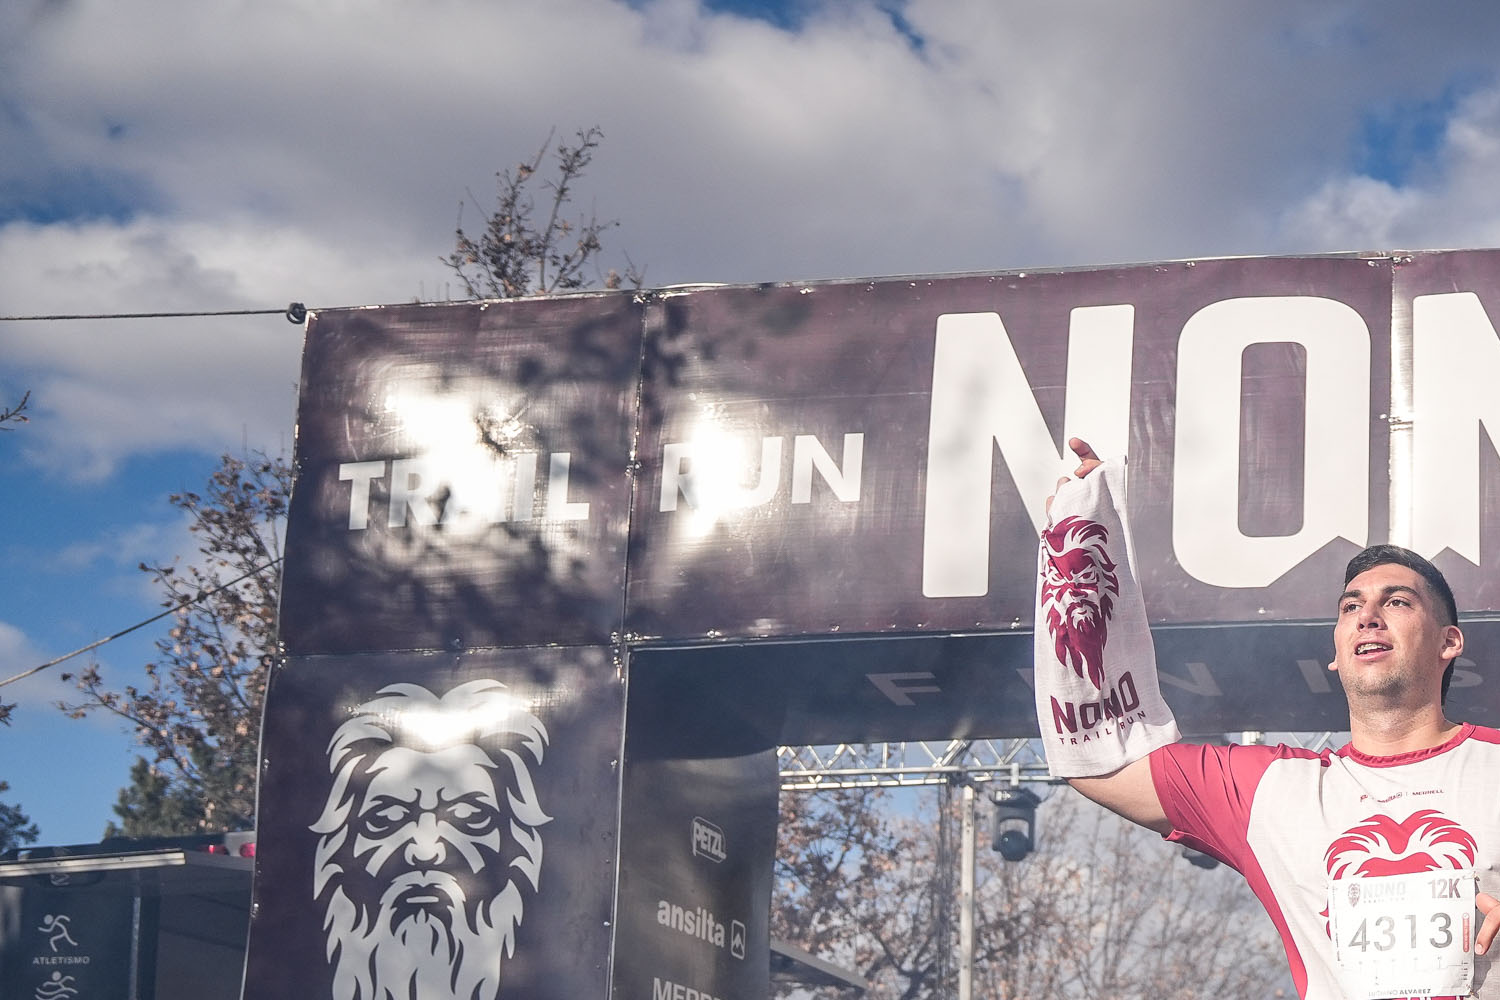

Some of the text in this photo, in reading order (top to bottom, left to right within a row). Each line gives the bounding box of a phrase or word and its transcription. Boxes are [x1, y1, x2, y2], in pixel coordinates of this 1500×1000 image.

[660, 432, 864, 512] RUN
[1050, 671, 1140, 735] NONO
[1059, 710, 1146, 745] TRAIL RUN
[692, 821, 727, 860] PETZL
[1428, 878, 1461, 899] 12K
[657, 900, 726, 948] ansilta
[1348, 912, 1453, 952] 4313
[32, 956, 90, 965] ATLETISMO
[1399, 988, 1432, 996] ALVAREZ
